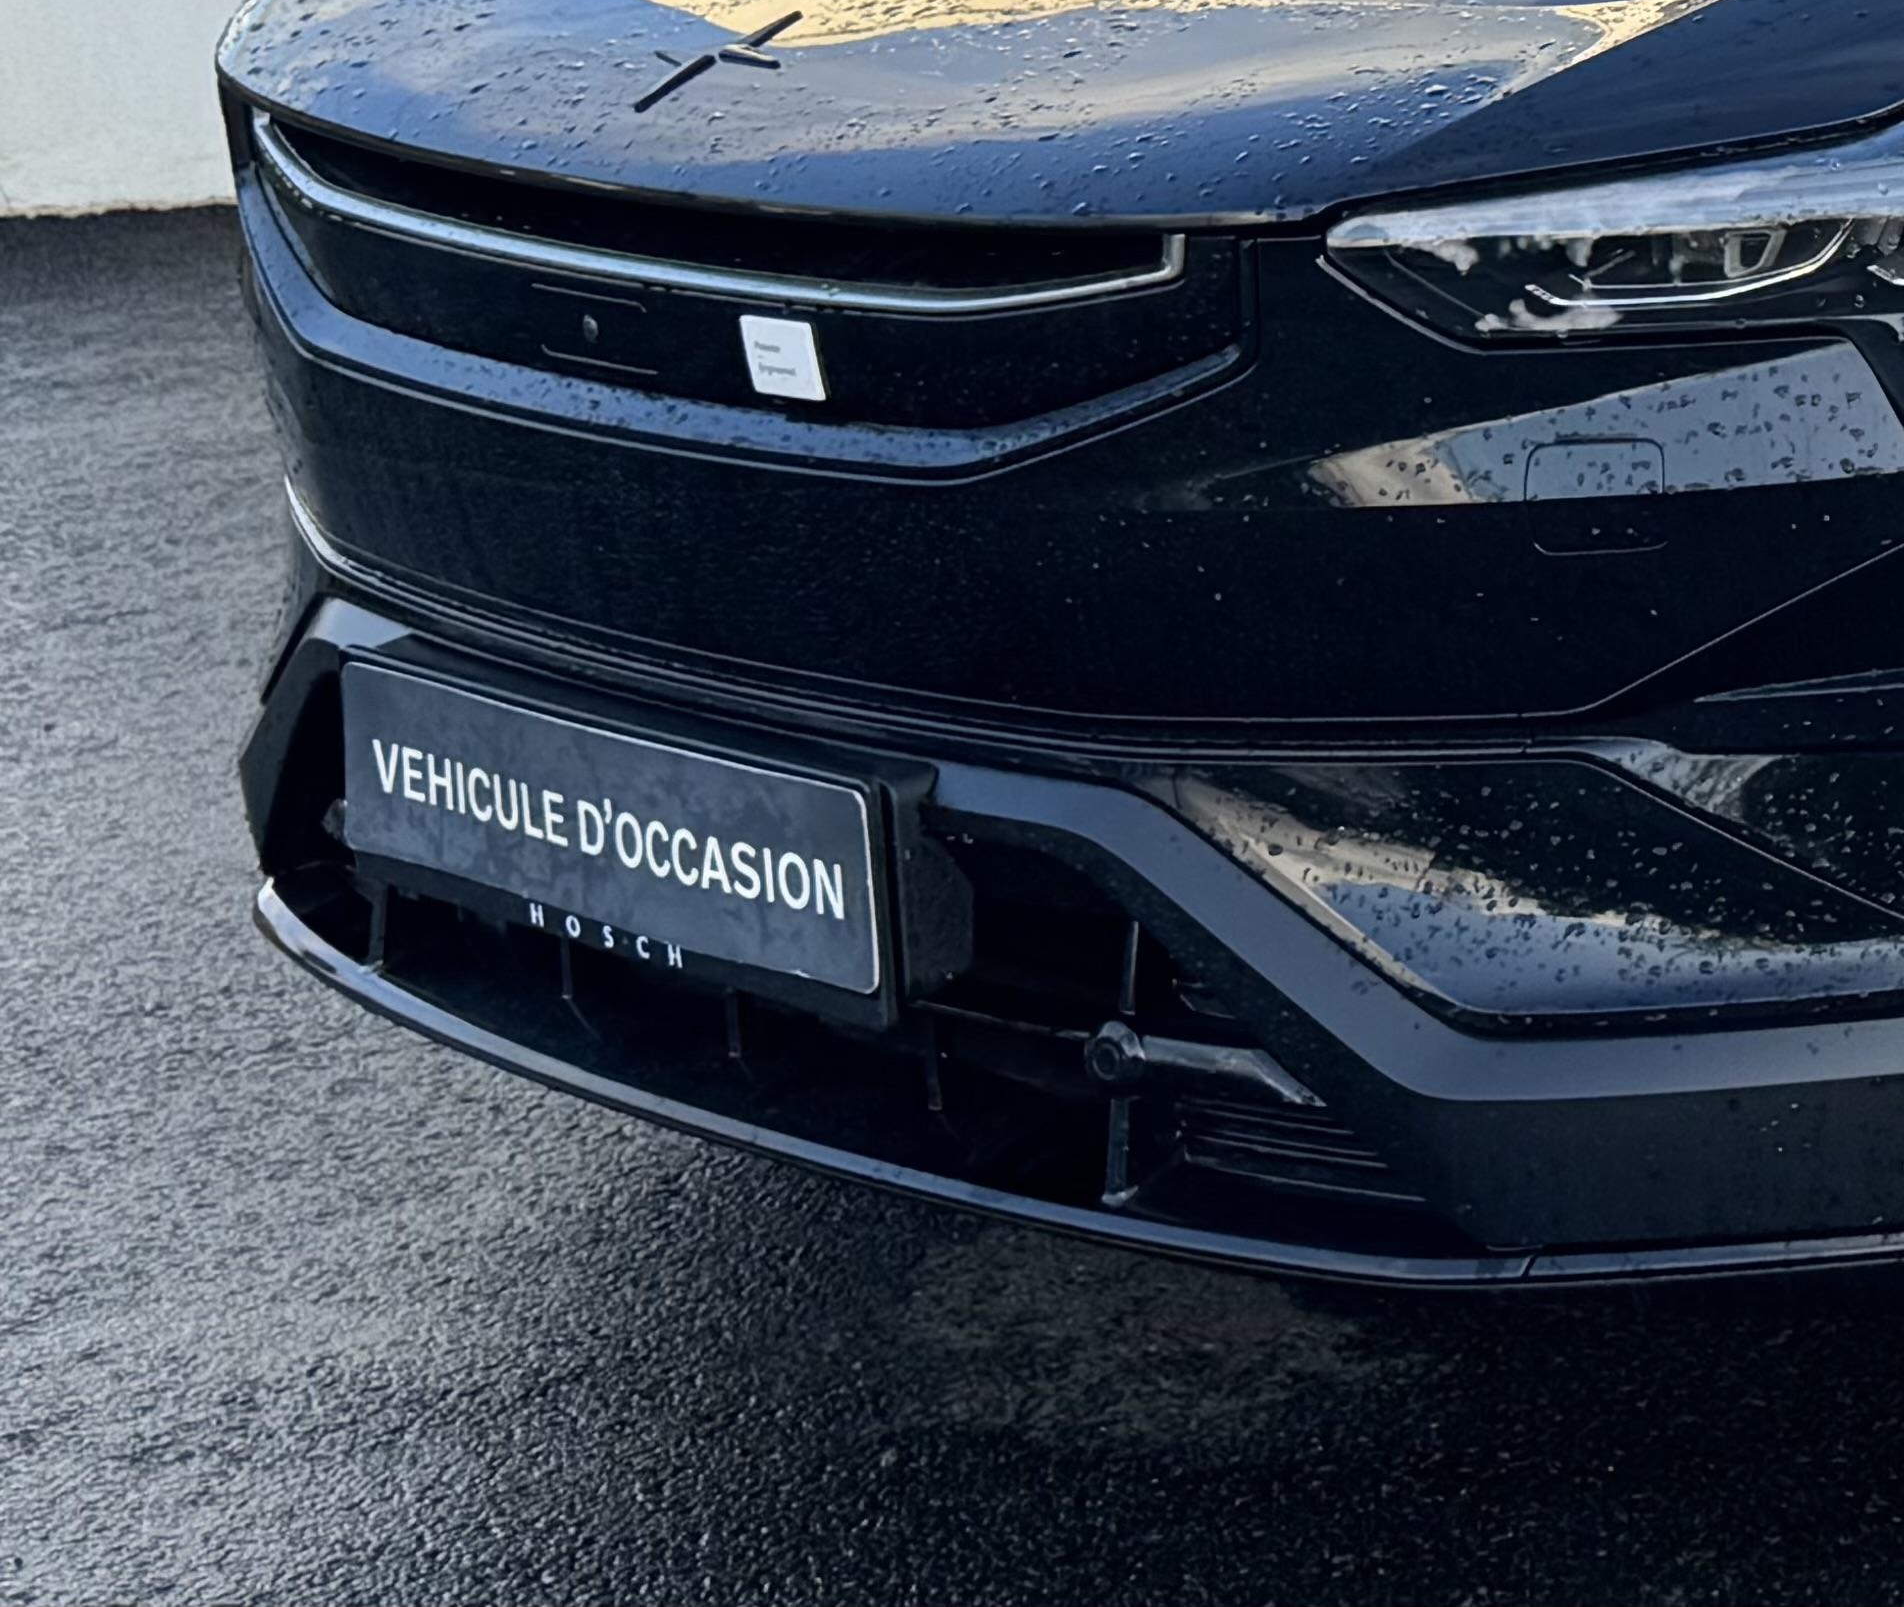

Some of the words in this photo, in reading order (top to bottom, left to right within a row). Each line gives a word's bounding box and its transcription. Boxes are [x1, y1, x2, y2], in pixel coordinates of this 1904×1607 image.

[371, 738, 569, 849] VEHICULE
[577, 797, 847, 920] D'OCCASION
[530, 902, 684, 970] HOSCH
